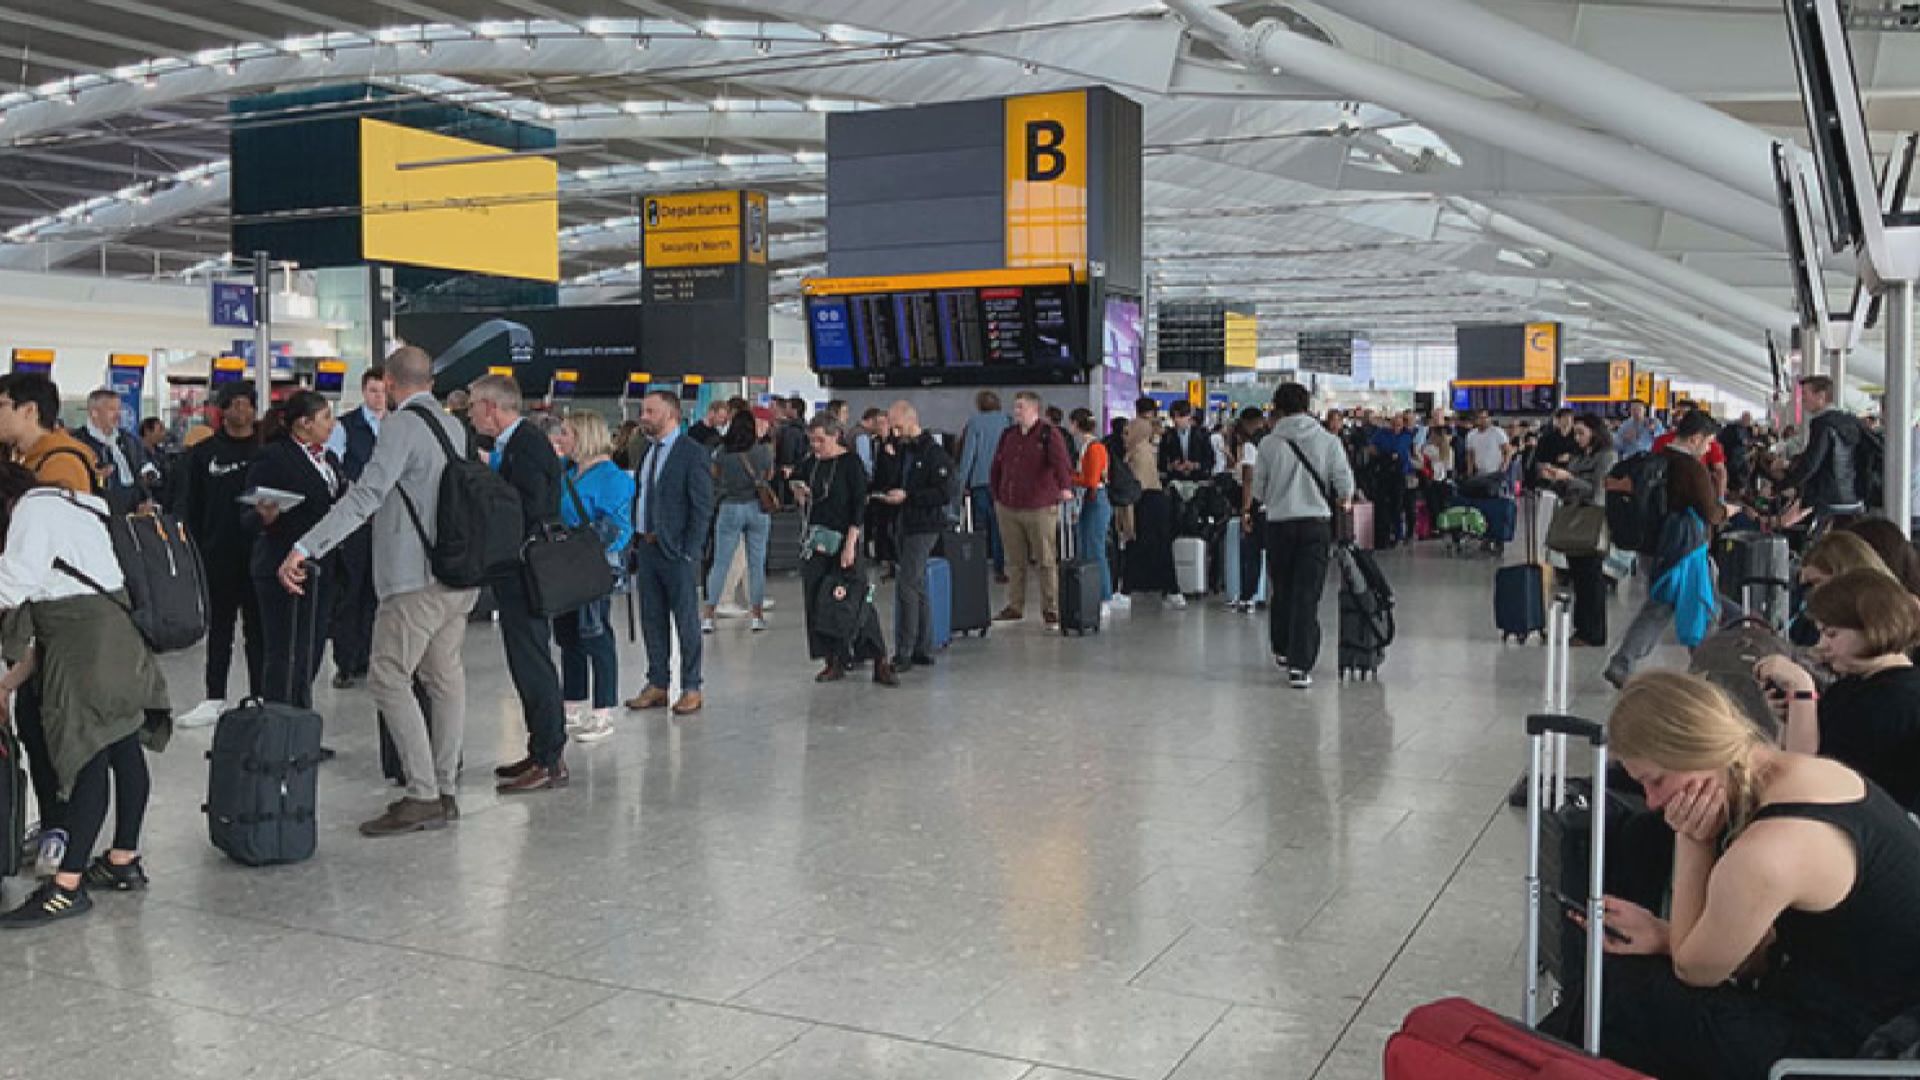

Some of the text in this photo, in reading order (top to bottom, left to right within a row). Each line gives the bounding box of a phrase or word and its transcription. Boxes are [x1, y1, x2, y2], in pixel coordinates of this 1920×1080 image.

[1026, 120, 1067, 182] B
[661, 203, 732, 220] Departures
[661, 241, 699, 253] Security
[1531, 331, 1548, 352] C
